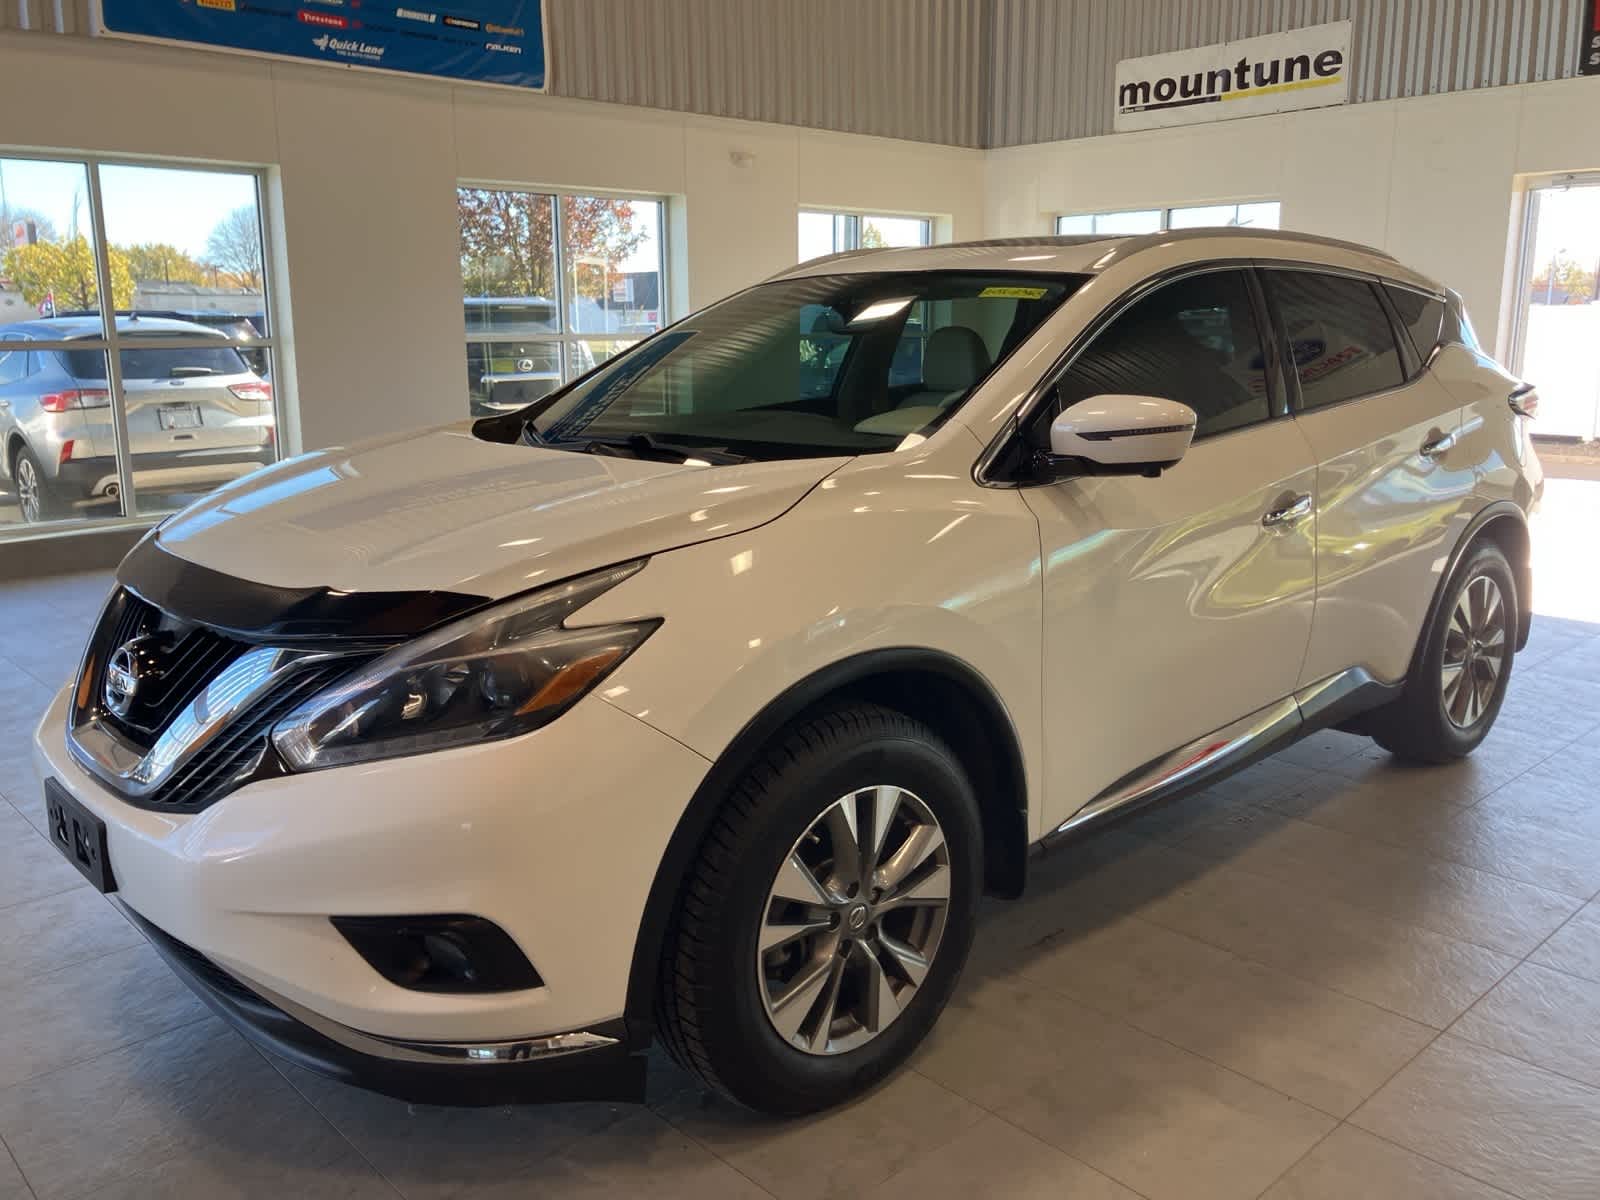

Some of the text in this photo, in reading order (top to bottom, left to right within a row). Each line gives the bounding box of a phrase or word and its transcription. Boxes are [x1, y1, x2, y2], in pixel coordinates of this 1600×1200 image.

[329, 38, 359, 52] Quick
[359, 42, 384, 56] Lane
[1119, 50, 1343, 107] mountune
